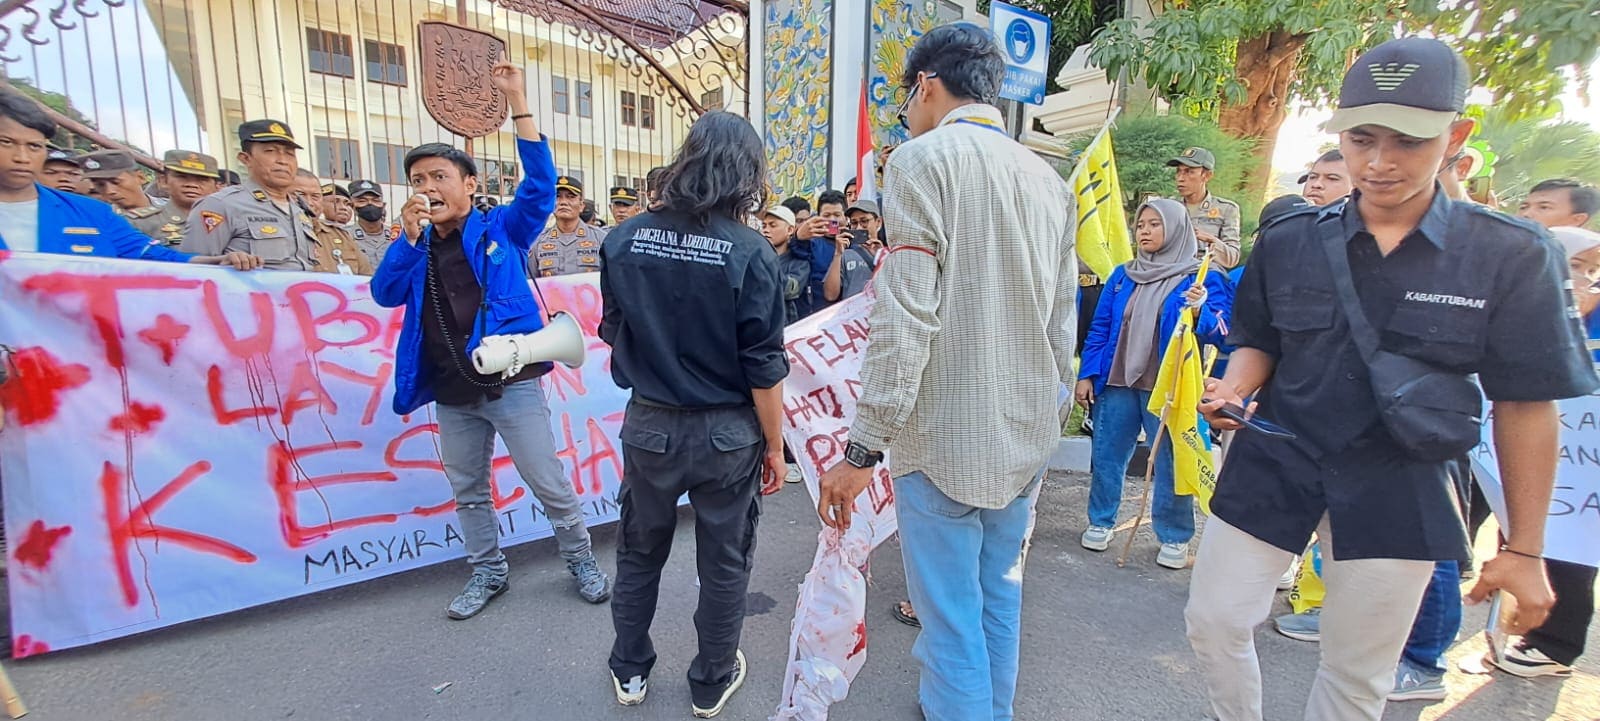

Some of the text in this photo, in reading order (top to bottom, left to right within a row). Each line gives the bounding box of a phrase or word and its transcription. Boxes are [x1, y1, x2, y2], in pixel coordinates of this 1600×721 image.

[1002, 82, 1031, 97] MASKER
[680, 233, 733, 254] ADHIMUKTI
[1404, 290, 1486, 309] KABARTUBAN
